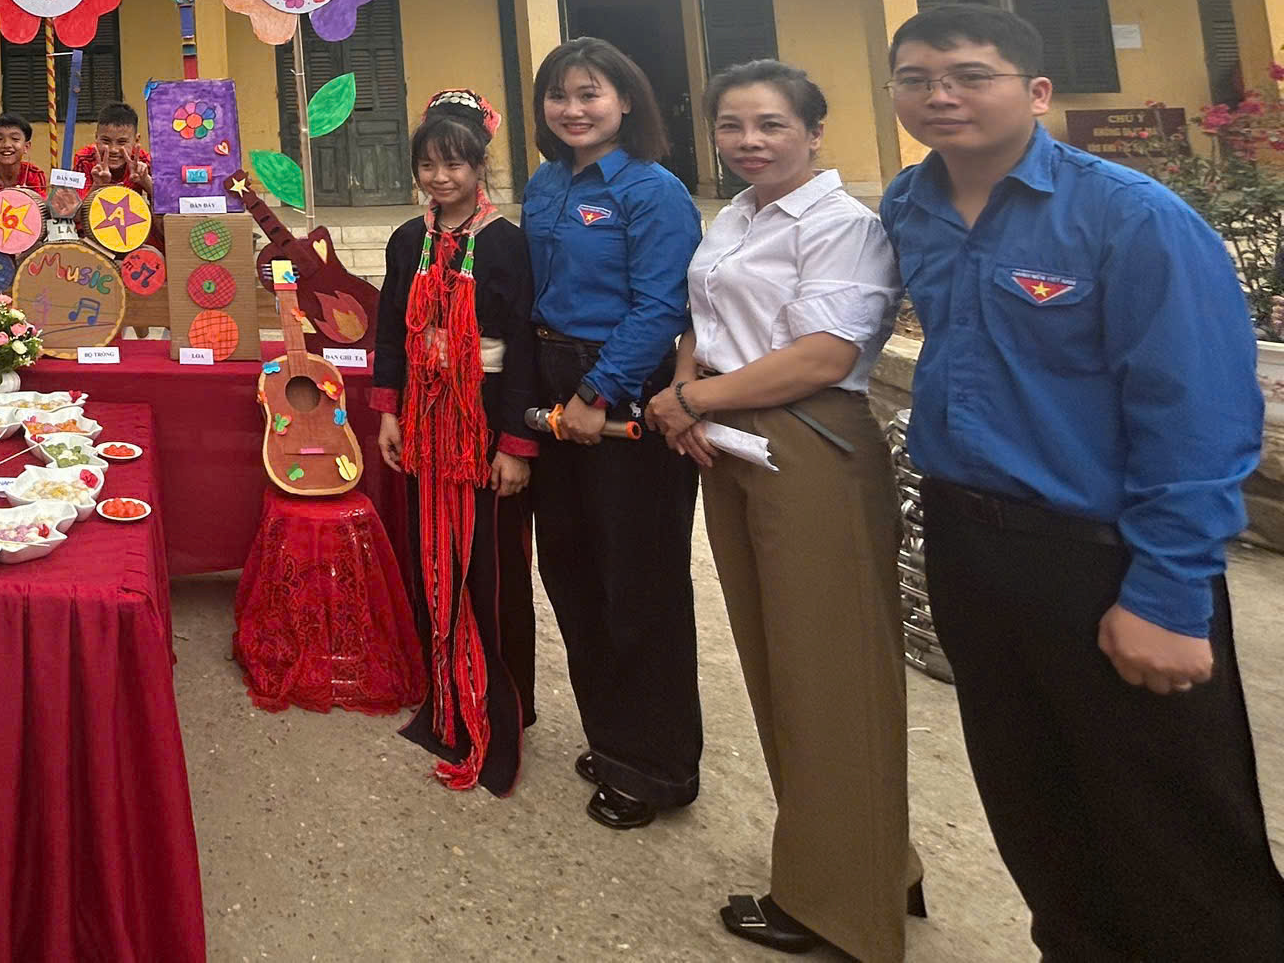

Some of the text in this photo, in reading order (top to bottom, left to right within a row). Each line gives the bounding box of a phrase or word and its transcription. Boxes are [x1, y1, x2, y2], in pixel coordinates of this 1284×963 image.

[1, 205, 19, 229] 6
[107, 206, 125, 226] A
[27, 252, 114, 295] Music
